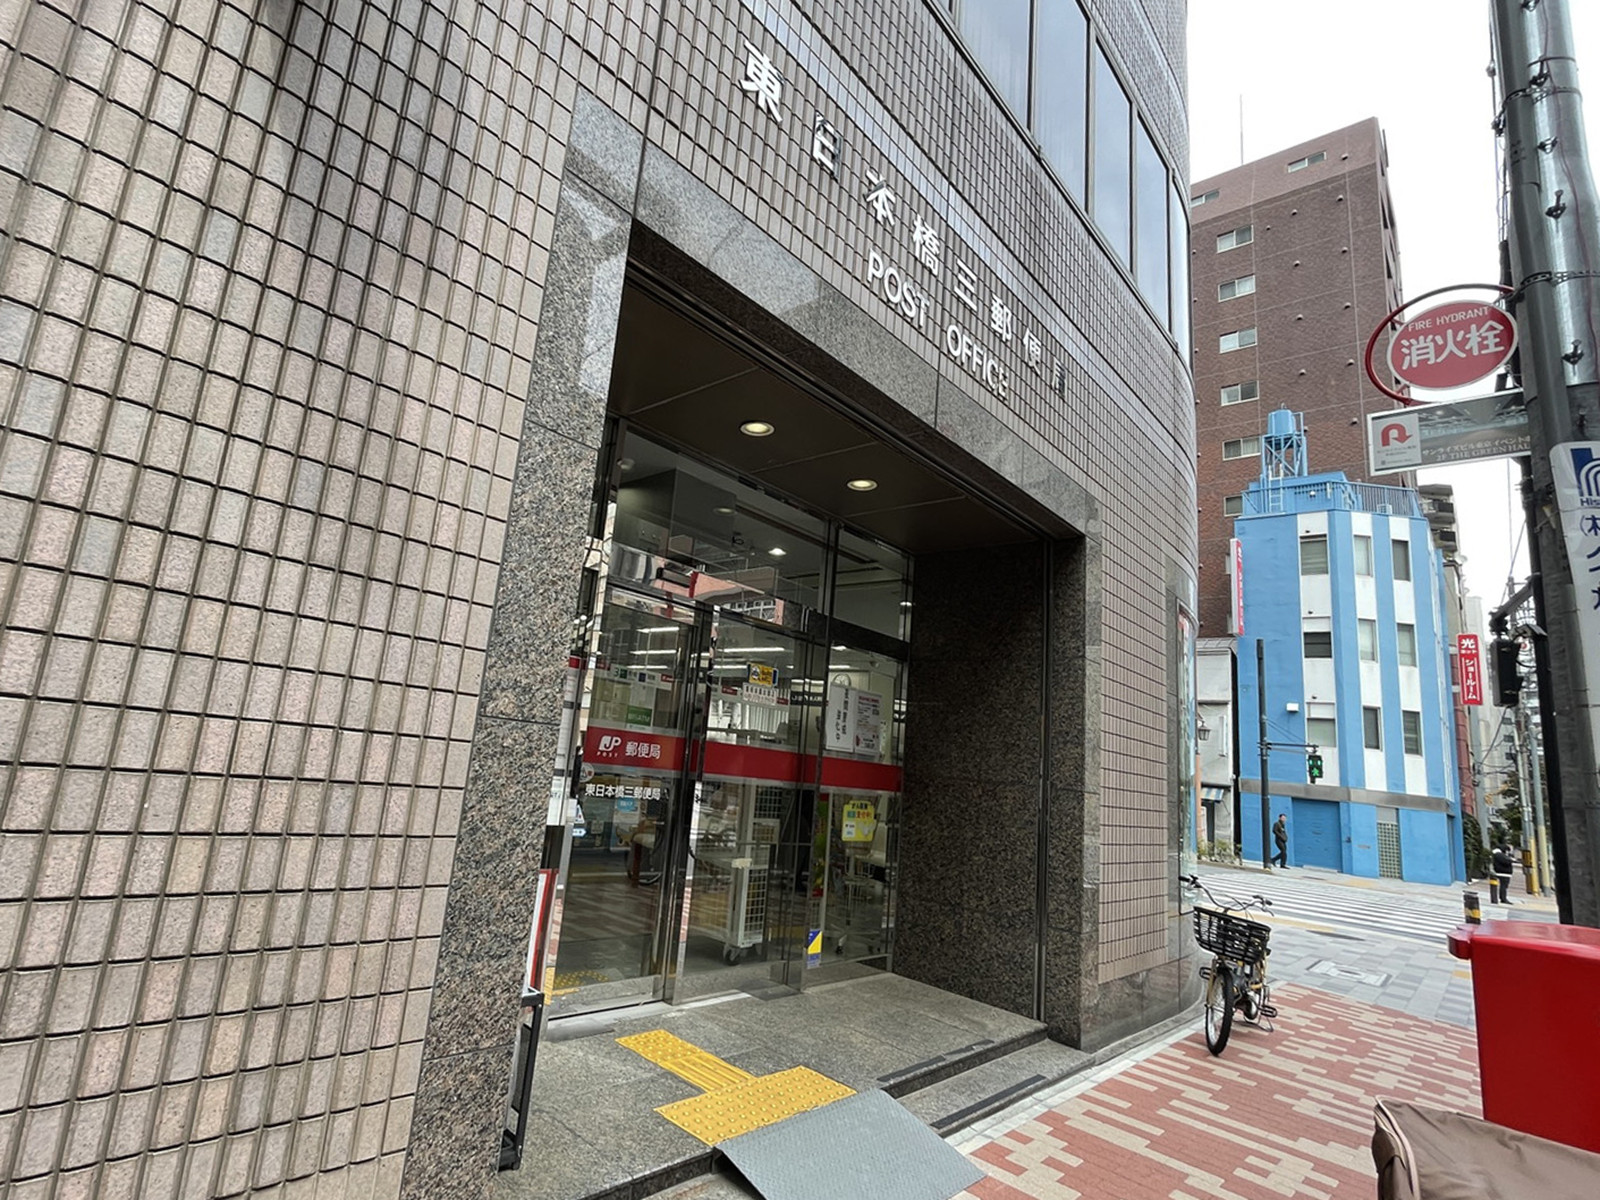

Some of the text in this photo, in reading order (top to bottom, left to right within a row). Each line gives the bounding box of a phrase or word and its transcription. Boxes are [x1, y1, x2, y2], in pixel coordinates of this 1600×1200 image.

[740, 39, 1068, 400] 東日本橋三郵便局
[867, 247, 1009, 399] POST OFFICE
[1408, 306, 1490, 332] FIRE HYDRANT
[1400, 319, 1505, 370] 消火栓
[1450, 450, 1471, 459] THE
[1508, 443, 1532, 452] HAL
[1461, 638, 1476, 649] 光
[1465, 659, 1477, 699] ショールーム
[625, 740, 661, 759] 郵便局
[585, 783, 661, 800] 東日本橋三郵便局
